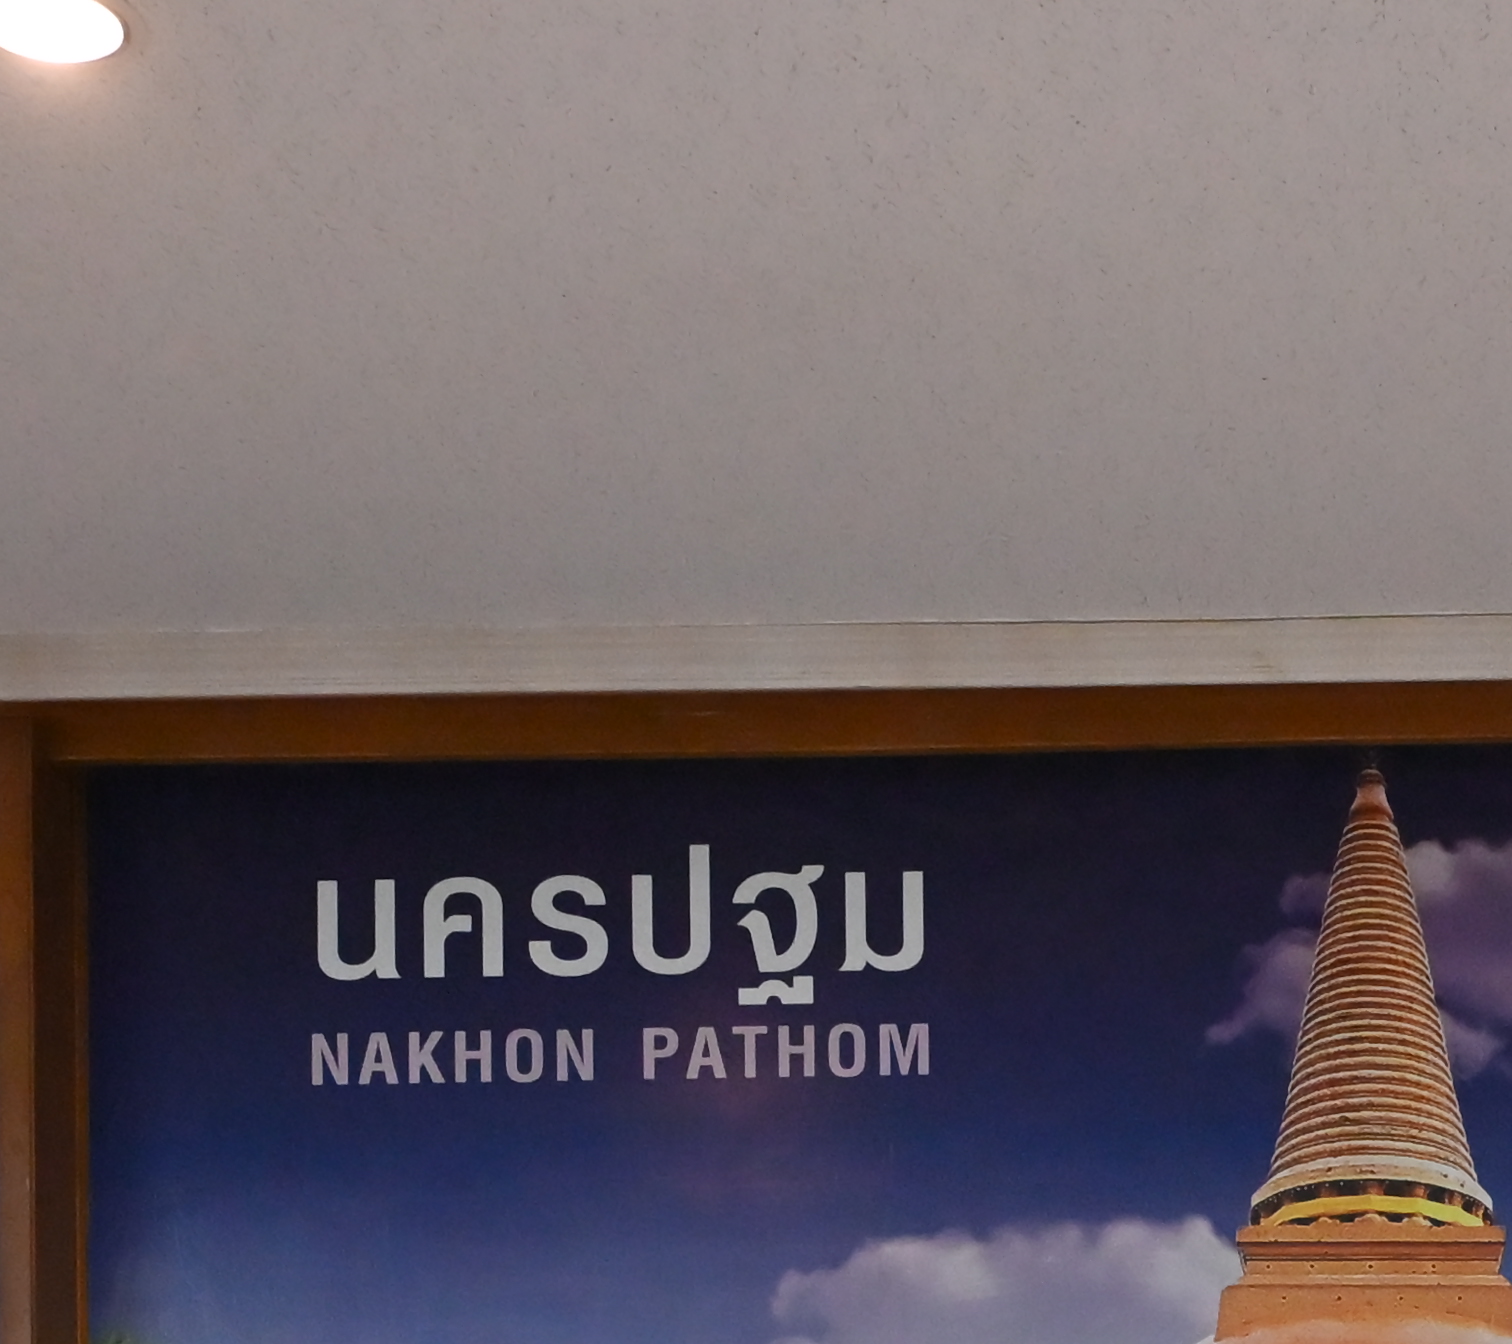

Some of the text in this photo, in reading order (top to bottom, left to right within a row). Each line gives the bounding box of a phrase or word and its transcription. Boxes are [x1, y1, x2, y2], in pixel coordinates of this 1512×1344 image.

[316, 844, 925, 1005] นครปฐม
[311, 1022, 931, 1086] NAKHON PATHOM
